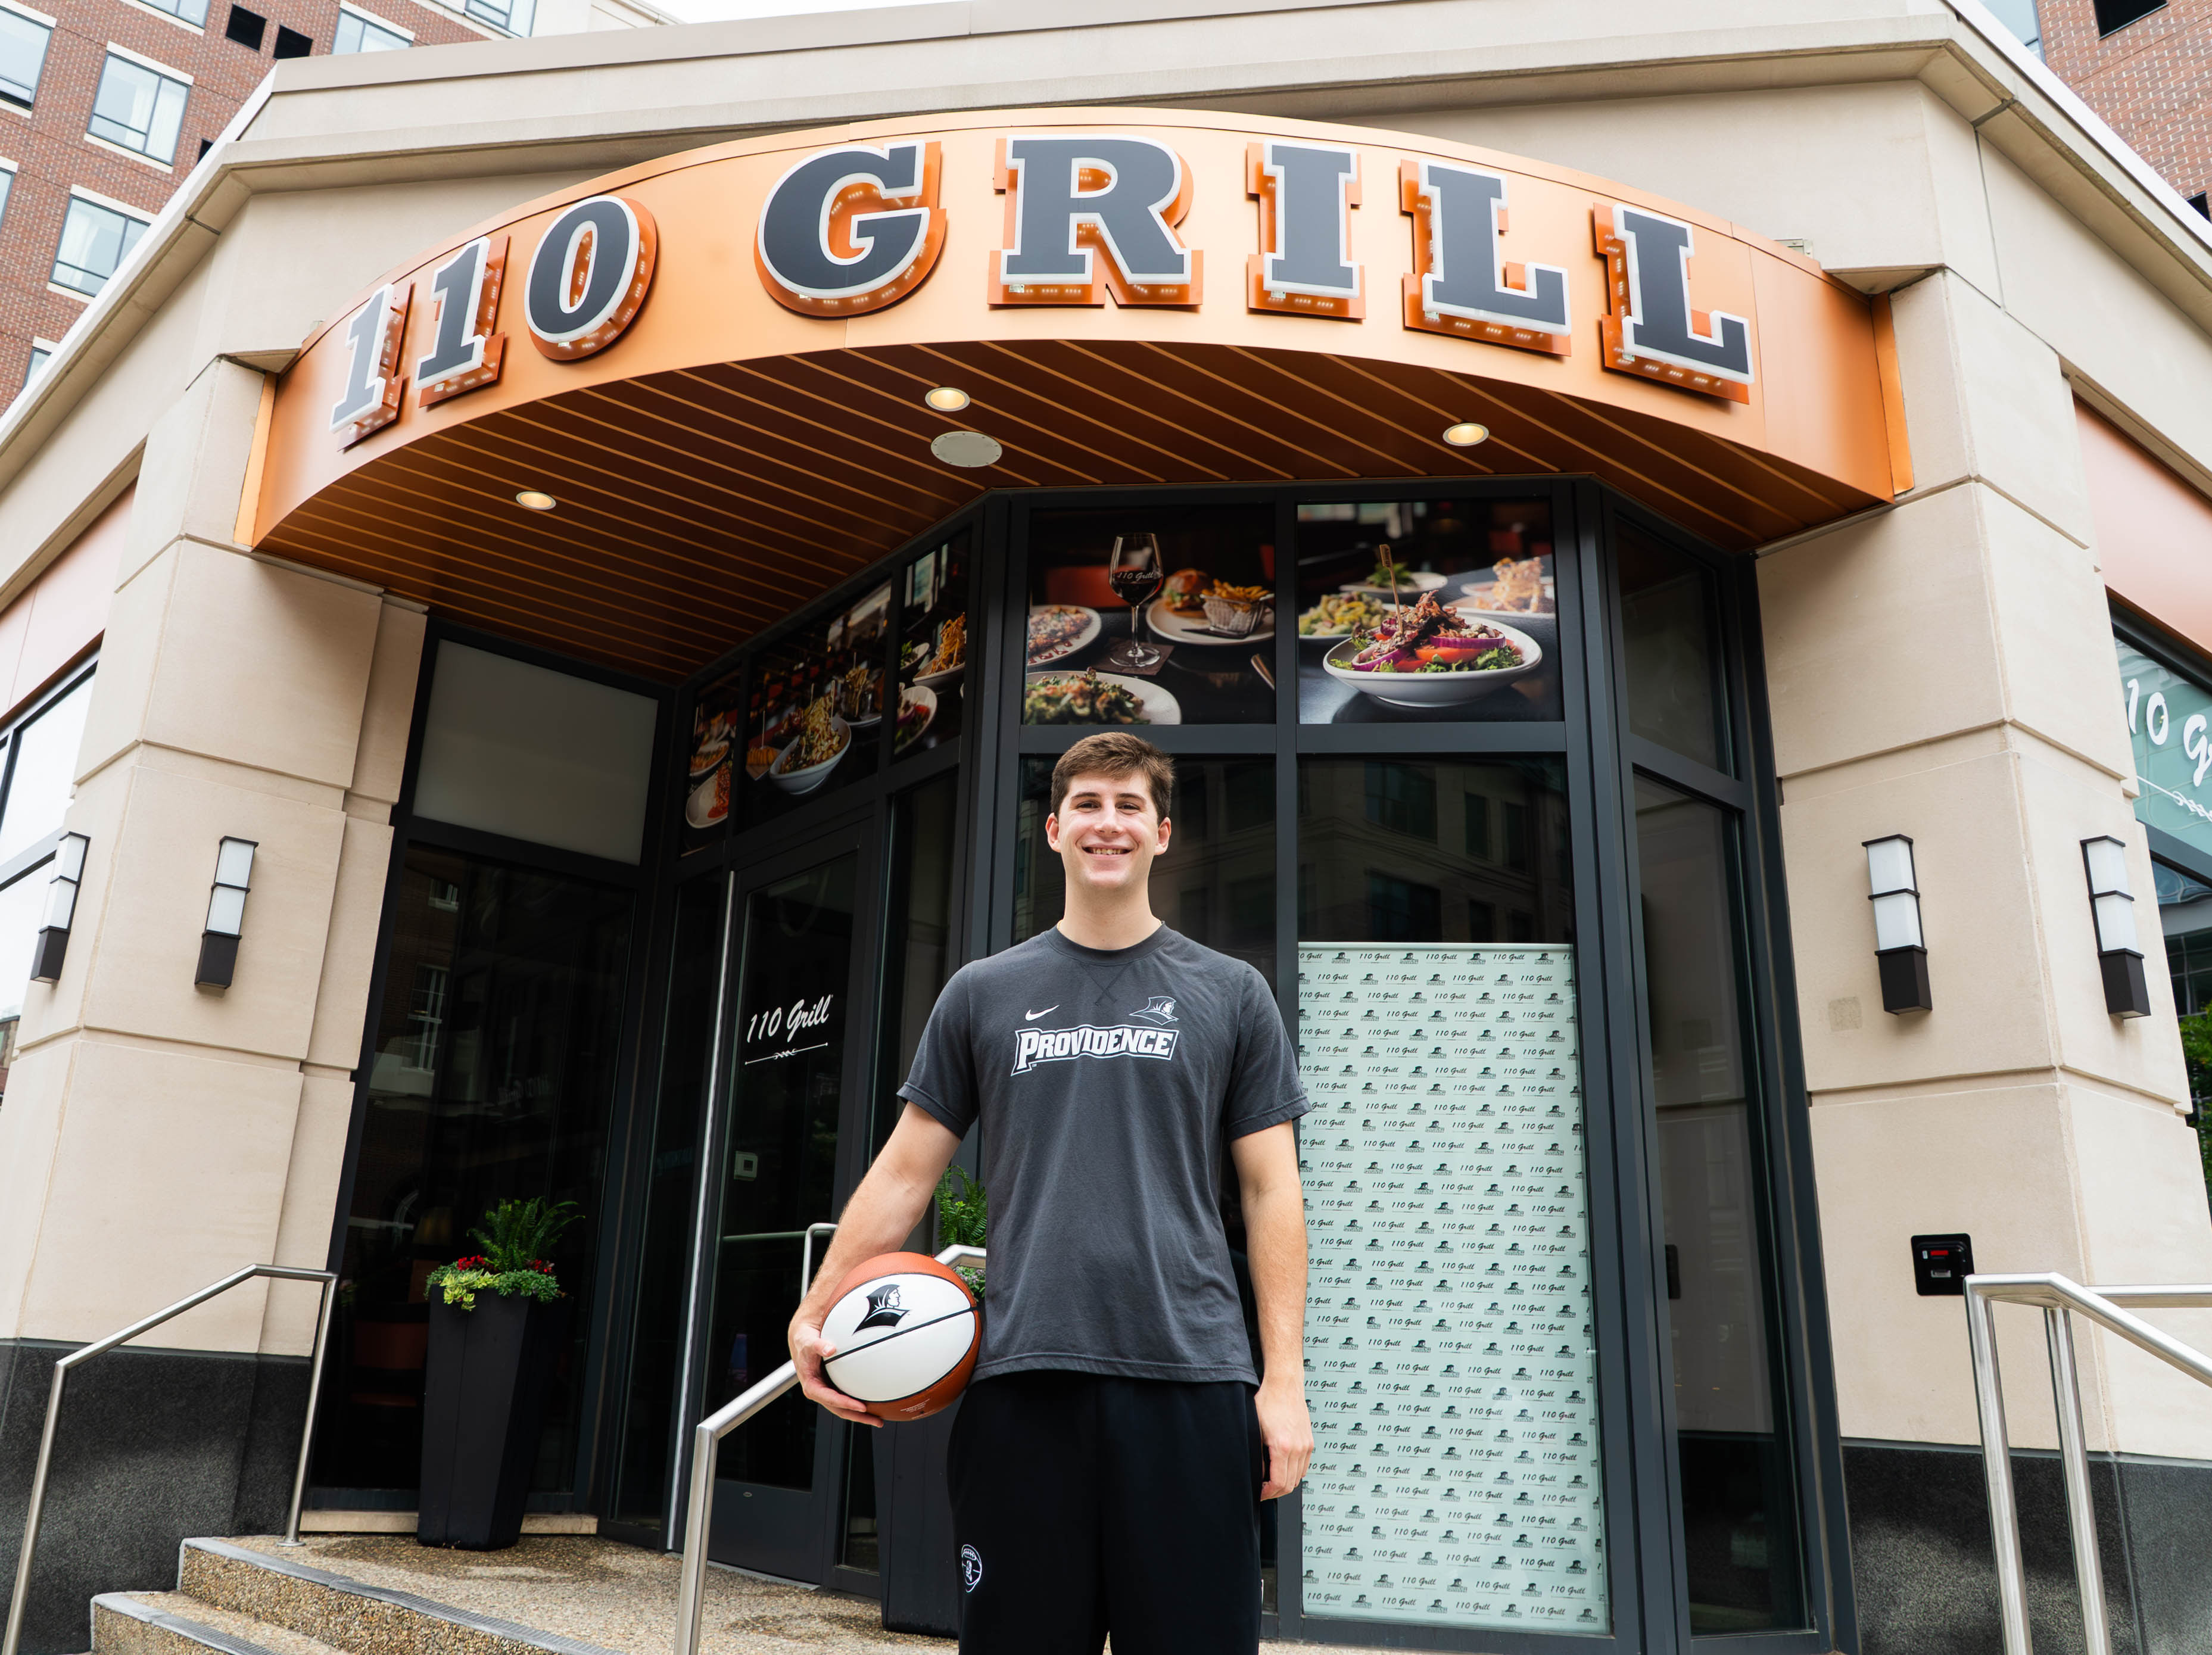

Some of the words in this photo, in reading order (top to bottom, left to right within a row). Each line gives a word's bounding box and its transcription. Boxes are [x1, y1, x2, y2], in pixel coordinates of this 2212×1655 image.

[330, 195, 643, 433] 110
[755, 134, 1754, 386] GRILL
[1135, 571, 1154, 582] Grill
[1375, 953, 1390, 961] Grill
[1536, 975, 1553, 983] Grill
[747, 1010, 782, 1043] 110
[787, 994, 831, 1043] Grill
[1402, 1011, 1418, 1019] Grill
[1383, 1029, 1400, 1037] Grill
[1519, 1030, 1535, 1039] Grill
[1015, 1026, 1176, 1072] PROVIDENCE
[1332, 1046, 1348, 1054] Grill
[1382, 1066, 1399, 1074] Grill
[1451, 1067, 1467, 1076] Grill
[1331, 1083, 1347, 1091] Grill
[1381, 1103, 1398, 1111] Grill
[1450, 1104, 1466, 1112] Grill
[1329, 1119, 1345, 1127] Grill
[1468, 1122, 1484, 1130] Grill
[1538, 1123, 1554, 1132] Grill
[1448, 1142, 1465, 1150] Grill
[1336, 1161, 1353, 1170] Grill
[1476, 1165, 1493, 1173] Grill
[1546, 1166, 1563, 1175] Grill
[1388, 1182, 1404, 1190] Grill
[1527, 1185, 1544, 1194] Grill
[1336, 1200, 1353, 1208] Grill
[1477, 1204, 1494, 1213] Grill
[1388, 1221, 1405, 1230] Grill
[1528, 1225, 1546, 1234] Grill
[1336, 1238, 1353, 1247] Grill
[1478, 1242, 1495, 1251] Grill
[1388, 1260, 1404, 1269] Grill
[1458, 1263, 1475, 1271] Grill
[1334, 1277, 1351, 1285] Grill
[1476, 1282, 1494, 1290] Grill
[1386, 1299, 1403, 1308] Grill
[1457, 1302, 1473, 1310] Grill
[1333, 1316, 1350, 1324] Grill
[1476, 1321, 1493, 1330] Grill
[1547, 1323, 1565, 1333] Grill
[1455, 1342, 1472, 1351] Grill
[1339, 1361, 1357, 1370] Grill
[1484, 1367, 1501, 1376] Grill
[1556, 1370, 1574, 1379] Grill
[1393, 1383, 1410, 1392] Grill
[1537, 1389, 1554, 1398] Grill
[1340, 1402, 1357, 1410] Grill
[1485, 1408, 1503, 1417] Grill
[1394, 1425, 1410, 1434] Grill
[1538, 1432, 1556, 1441] Grill
[1340, 1442, 1357, 1451] Grill
[1485, 1450, 1503, 1458] Grill
[1393, 1467, 1410, 1476] Grill
[1465, 1470, 1483, 1479] Grill
[1338, 1483, 1355, 1492] Grill
[1485, 1491, 1503, 1500] Grill
[1391, 1508, 1409, 1517] Grill
[1465, 1512, 1482, 1521] Grill
[1336, 1525, 1353, 1534] Grill
[1484, 1533, 1501, 1542] Grill
[1558, 1537, 1576, 1546] Grill
[1463, 1554, 1480, 1564] Grill
[1344, 1573, 1361, 1582] Grill
[1493, 1582, 1510, 1591] Grill
[1568, 1587, 1585, 1595] Grill
[1398, 1598, 1416, 1607] Grill
[1547, 1607, 1565, 1616] Grill
